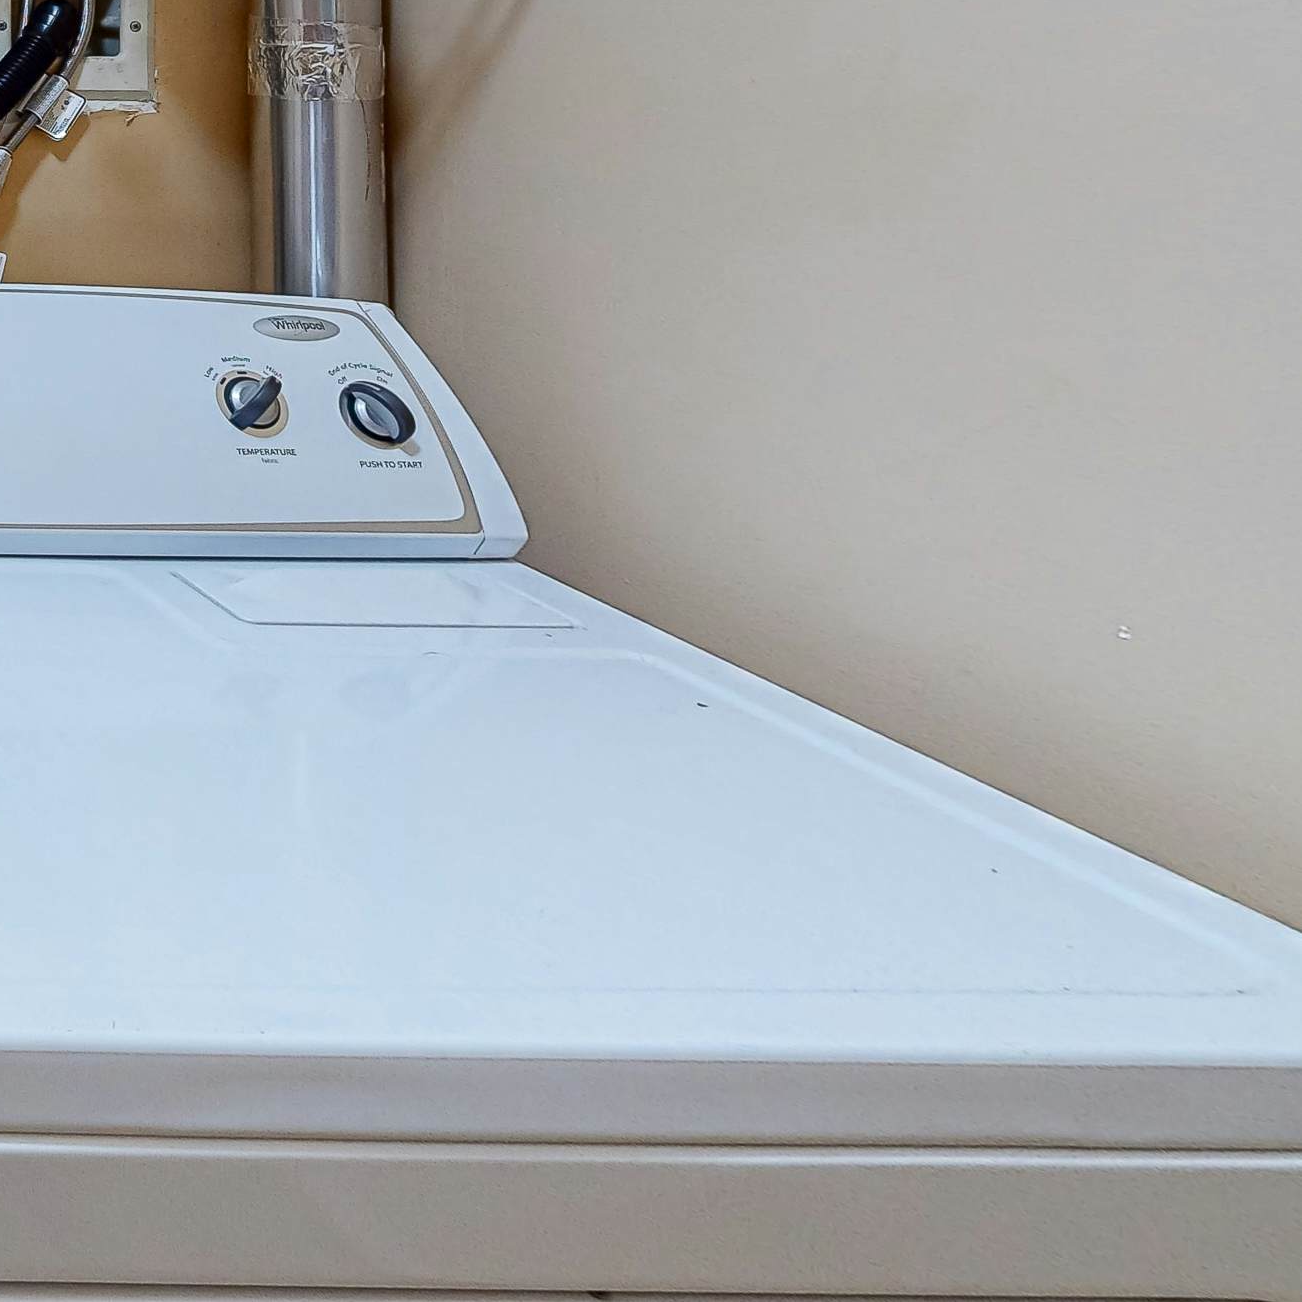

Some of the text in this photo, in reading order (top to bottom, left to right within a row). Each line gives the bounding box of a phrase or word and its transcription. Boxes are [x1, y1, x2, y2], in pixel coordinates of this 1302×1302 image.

[272, 319, 326, 332] Whirlpool
[328, 366, 340, 376] End
[348, 362, 368, 370] Cycle
[369, 364, 394, 377] Signal
[337, 376, 347, 385] Off
[236, 448, 297, 456] TEMPERATURE
[359, 460, 383, 469] PUSH
